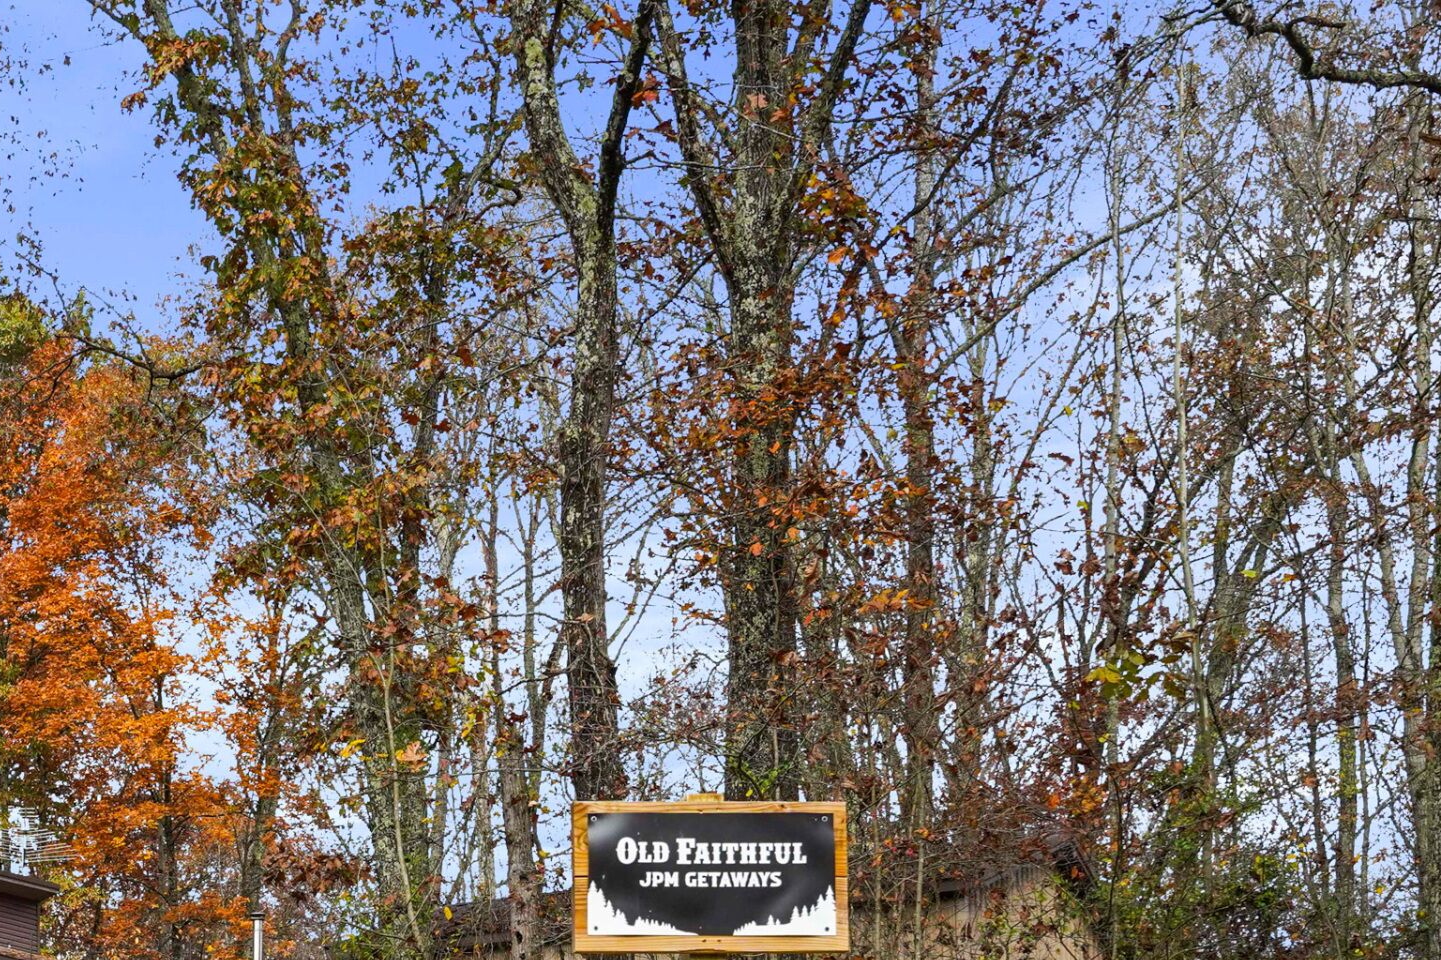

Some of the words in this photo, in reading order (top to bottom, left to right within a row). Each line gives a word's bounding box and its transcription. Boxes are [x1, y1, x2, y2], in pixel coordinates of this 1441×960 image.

[616, 837, 670, 865] OLD
[676, 837, 808, 865] FAITHFUL
[639, 871, 680, 888] JPM
[684, 871, 783, 888] GETAWAYS
